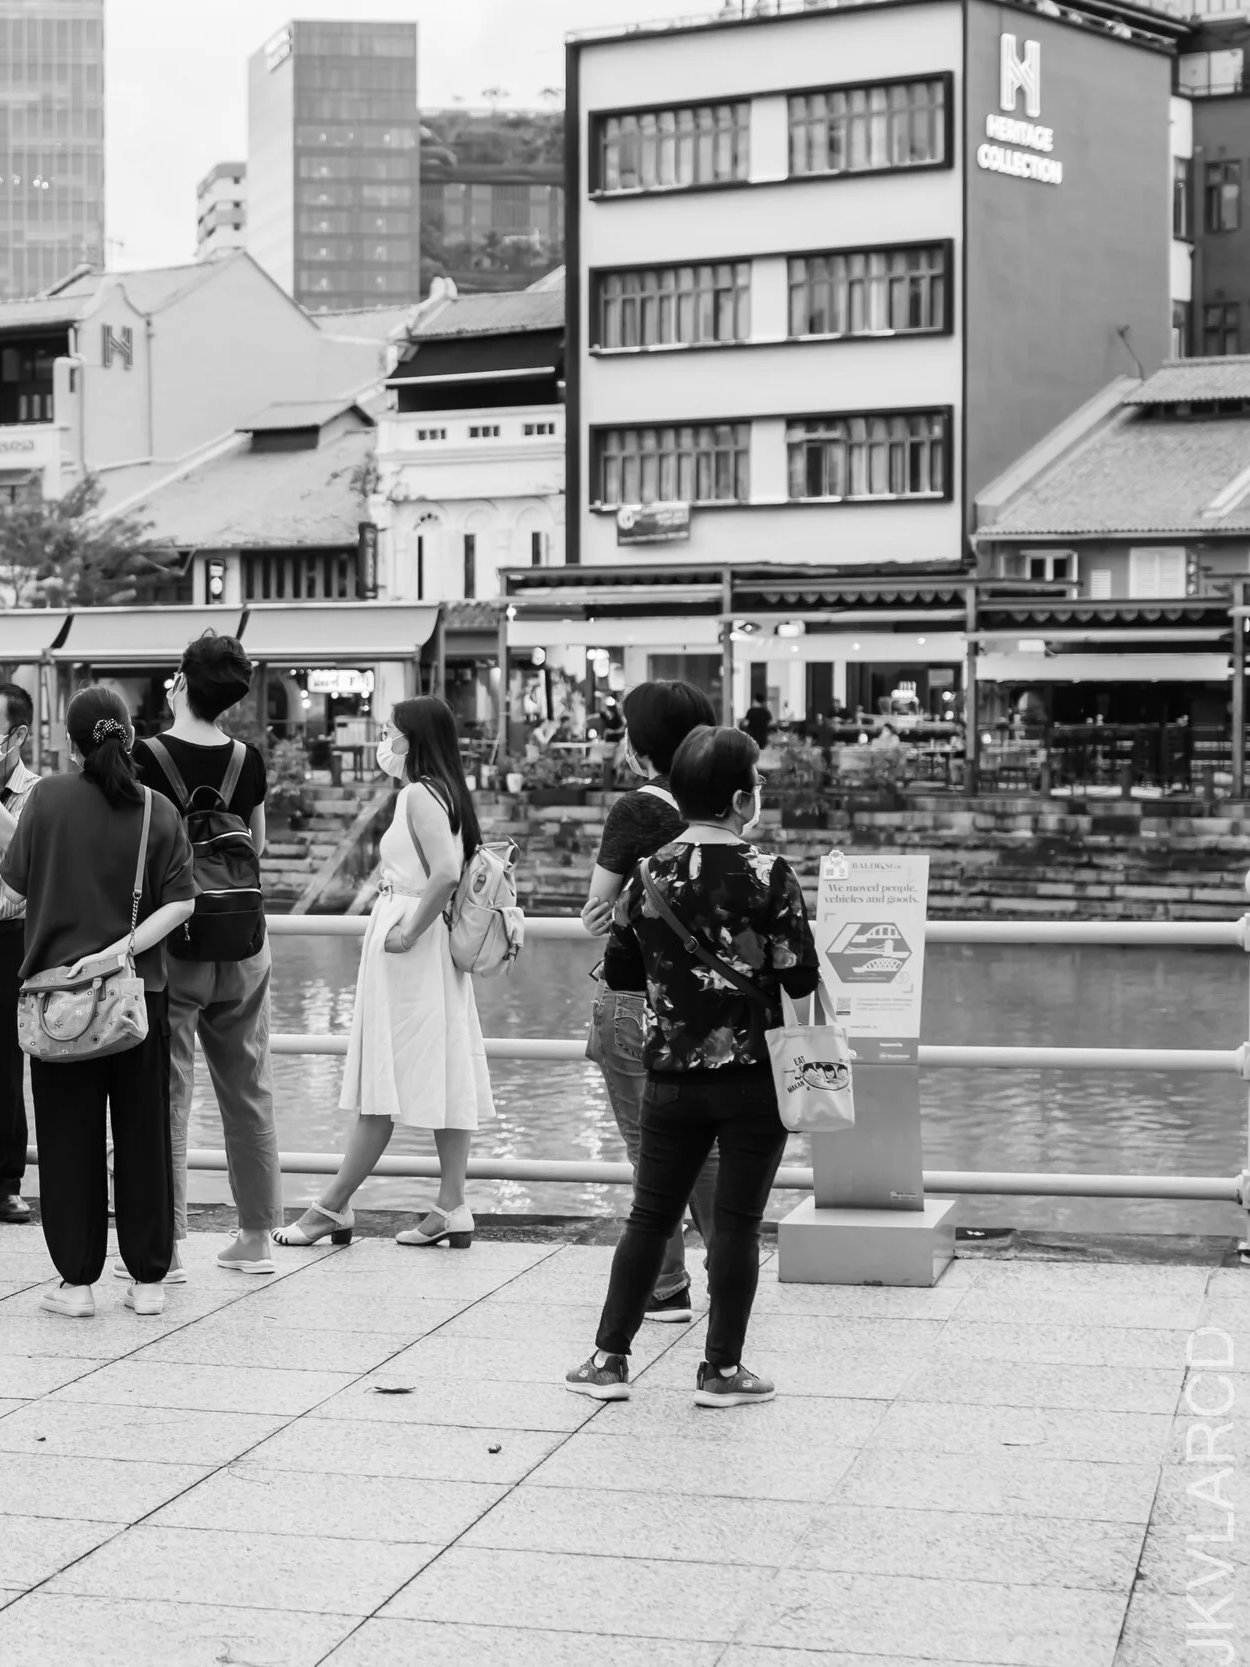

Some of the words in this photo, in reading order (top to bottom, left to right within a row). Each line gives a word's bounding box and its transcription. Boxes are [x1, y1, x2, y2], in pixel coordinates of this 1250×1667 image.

[986, 114, 1054, 152] HERITAGE
[977, 144, 1063, 184] COLLECTION
[828, 884, 844, 892] We
[846, 883, 879, 892] moved
[824, 894, 864, 903] vehicles
[865, 894, 885, 903] and
[793, 1055, 806, 1066] EAT
